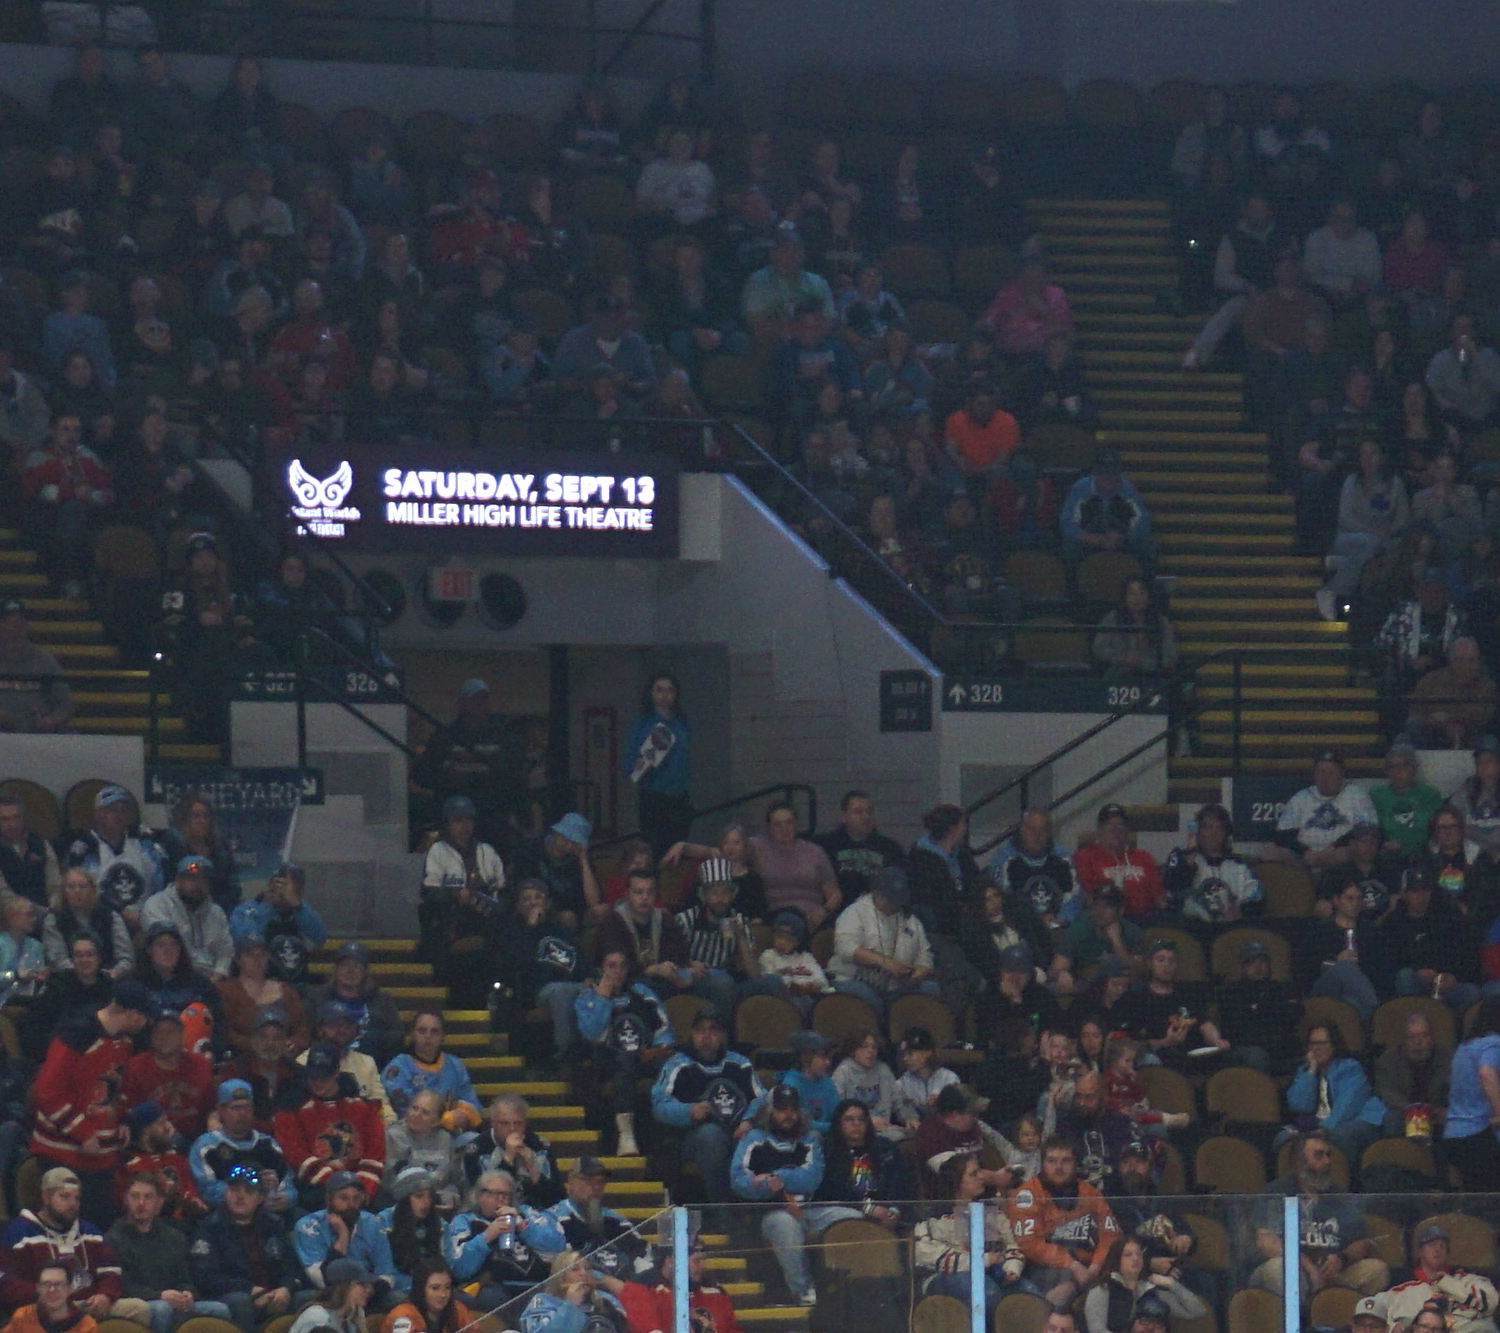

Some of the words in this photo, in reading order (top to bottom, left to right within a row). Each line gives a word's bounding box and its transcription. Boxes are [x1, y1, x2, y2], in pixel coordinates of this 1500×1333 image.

[384, 469, 538, 504] SATURDAY,
[546, 472, 615, 502] SEPT
[386, 502, 459, 524] MILLER
[463, 504, 516, 526] HIGH
[519, 505, 562, 528] LIFE
[564, 506, 653, 530] THEATRE
[970, 684, 1002, 704] 328
